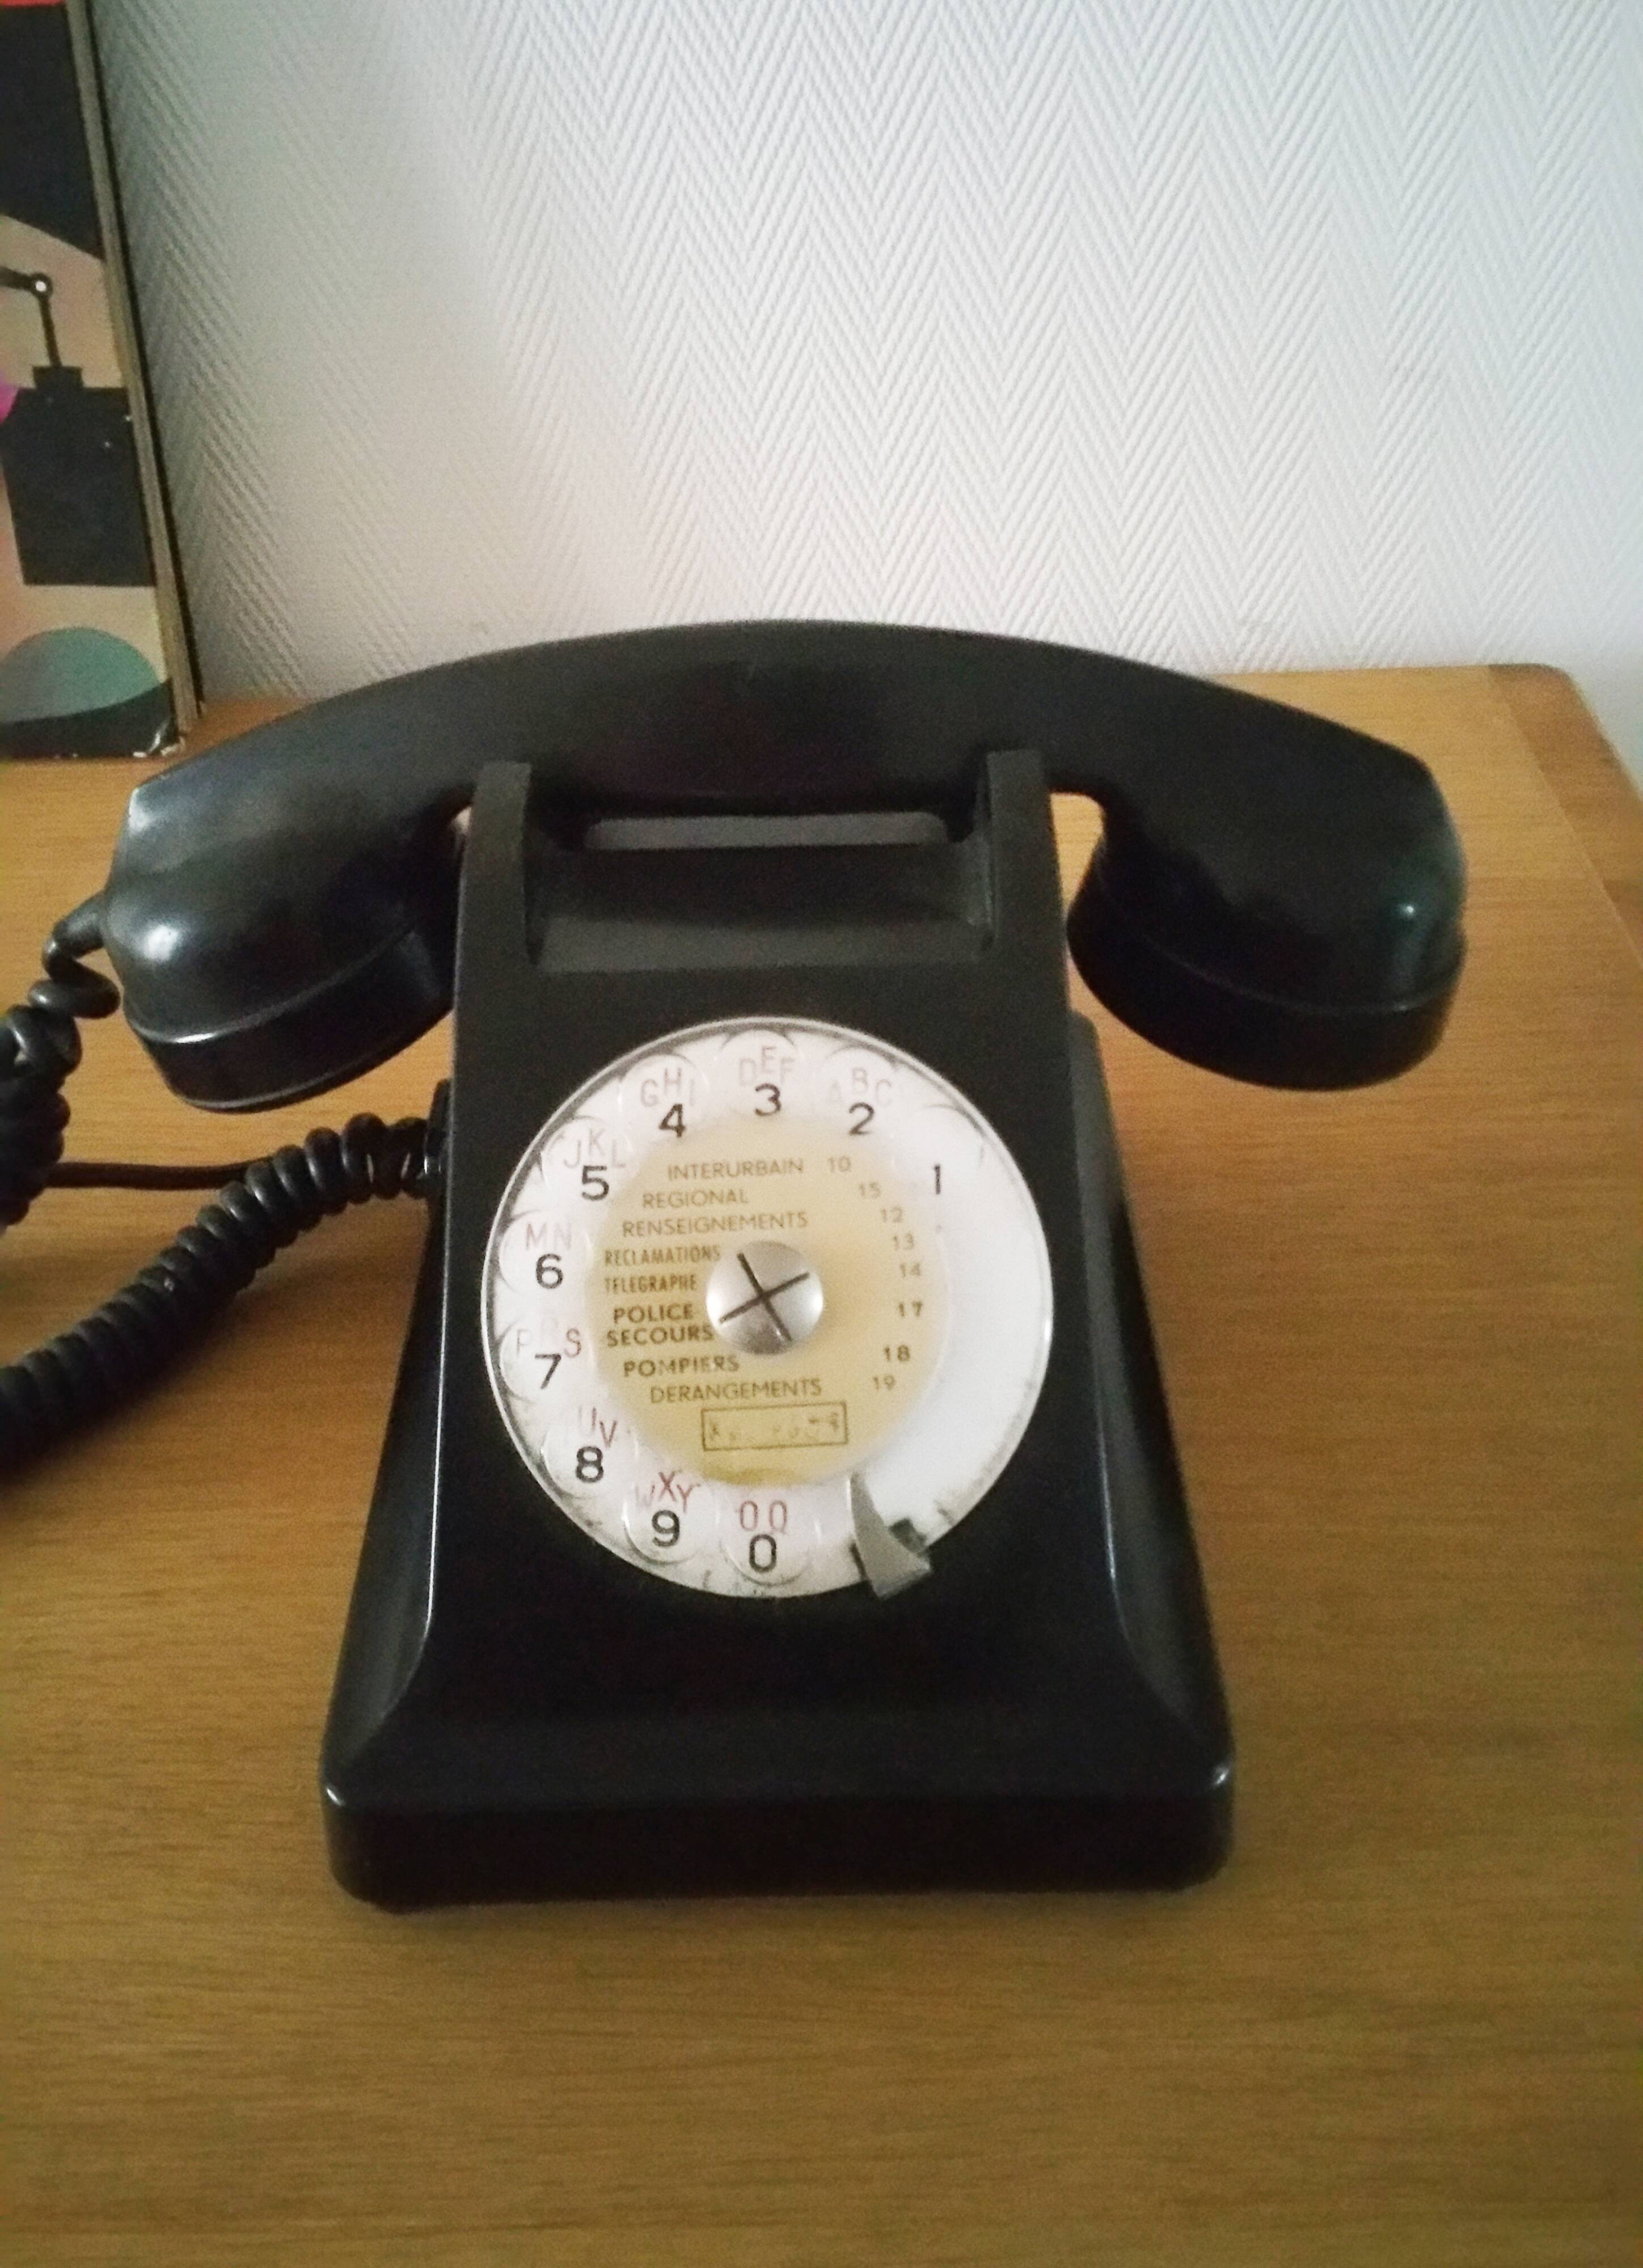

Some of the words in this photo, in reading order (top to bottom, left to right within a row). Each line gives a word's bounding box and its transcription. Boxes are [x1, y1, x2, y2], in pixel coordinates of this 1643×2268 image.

[755, 1082, 782, 1116] 3
[658, 1103, 686, 1138] 4
[848, 1102, 875, 1136] 2
[581, 1165, 610, 1201] 5
[668, 1158, 804, 1182] INTERURBAIN
[827, 1155, 851, 1173] 10
[642, 1188, 749, 1209] REGIONAL
[858, 1181, 882, 1200] 15
[623, 1211, 809, 1238] RENSEIGNEMENTS
[880, 1205, 903, 1224] 12
[604, 1244, 721, 1268] RECLAMATIONS
[892, 1232, 915, 1250] 13
[535, 1253, 564, 1290] 6
[899, 1262, 921, 1278] 14
[606, 1324, 716, 1349] SECOURS
[898, 1301, 923, 1318] 17
[613, 1304, 694, 1325] POLICE
[534, 1353, 563, 1390] 7
[623, 1356, 741, 1378] POMPIERS
[883, 1344, 910, 1363] 18
[650, 1378, 822, 1405] DERANGEMENTS
[872, 1374, 896, 1391] 19
[575, 1446, 604, 1484] 8
[651, 1509, 681, 1548] 9
